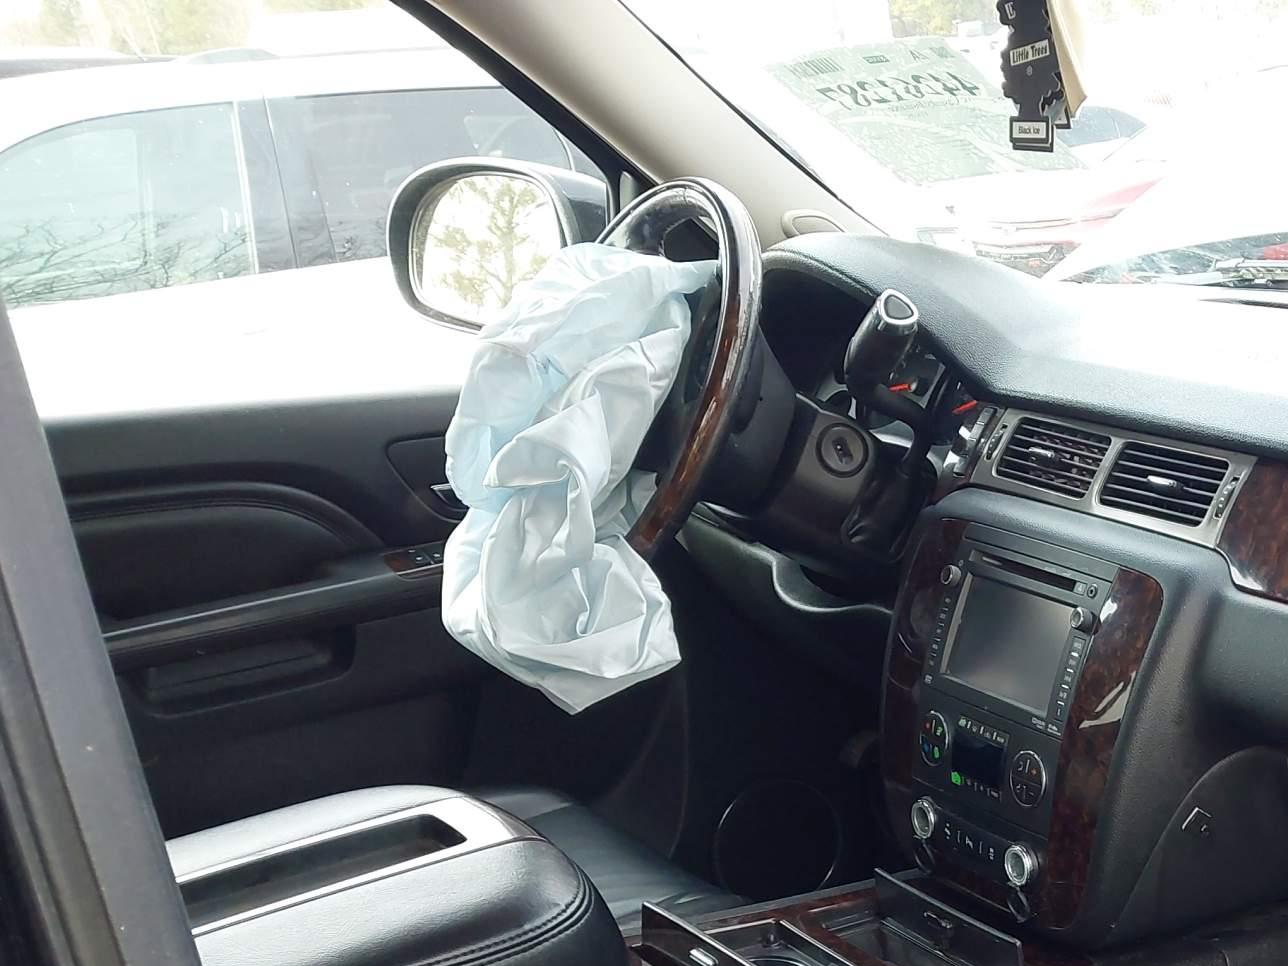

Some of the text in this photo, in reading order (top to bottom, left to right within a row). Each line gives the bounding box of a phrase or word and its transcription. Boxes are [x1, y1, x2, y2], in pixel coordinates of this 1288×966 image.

[1011, 42, 1049, 64] Little Trees
[1018, 126, 1032, 135] Black
